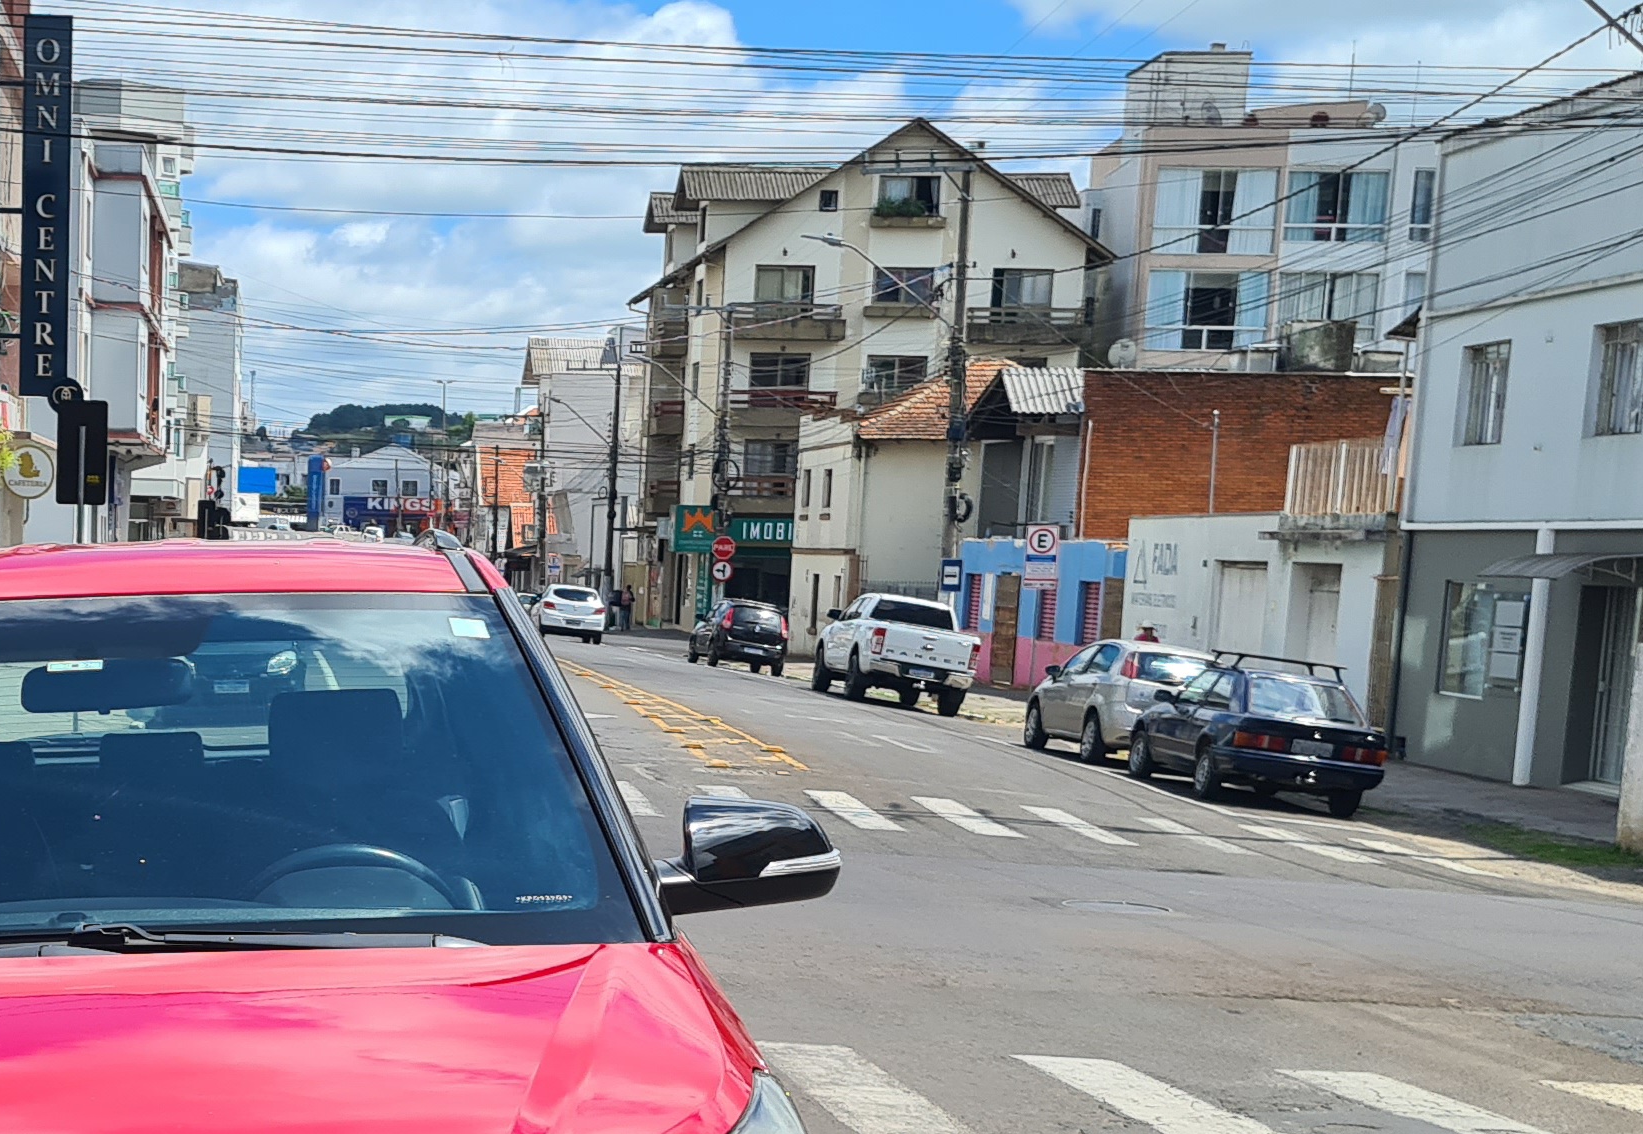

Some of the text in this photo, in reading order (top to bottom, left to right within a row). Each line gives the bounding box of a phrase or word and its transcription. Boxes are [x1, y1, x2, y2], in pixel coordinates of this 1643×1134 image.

[34, 38, 61, 377] OMNI CENTRE
[367, 497, 435, 512] KINGS
[713, 543, 735, 552] PARE
[1037, 534, 1048, 549] E
[885, 648, 967, 667] RANGER
